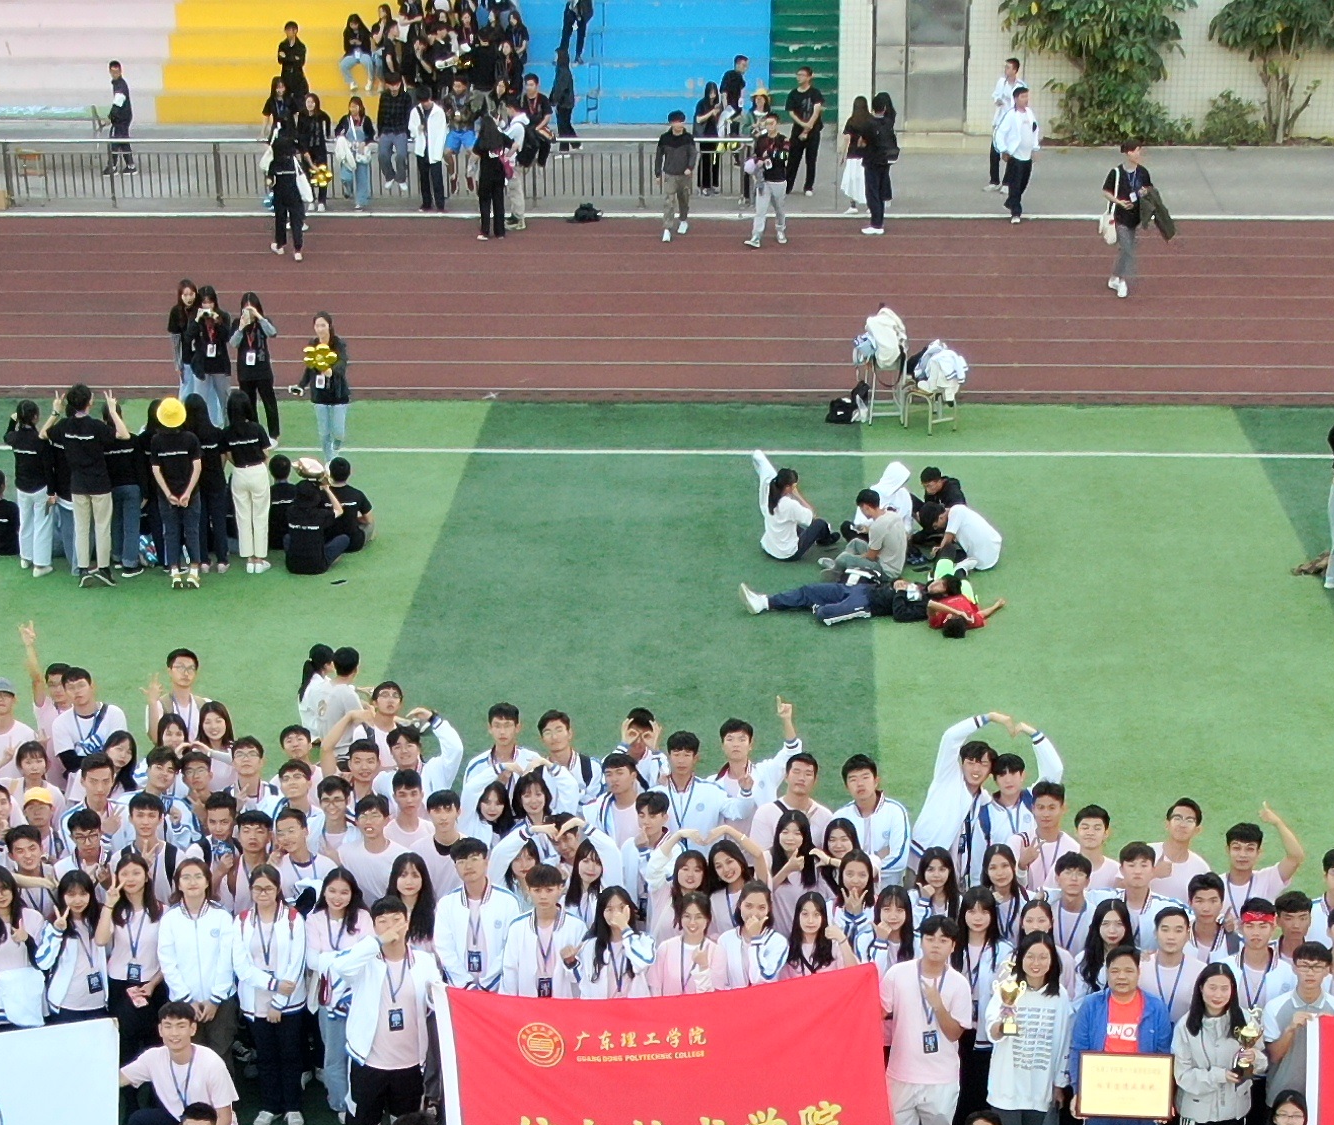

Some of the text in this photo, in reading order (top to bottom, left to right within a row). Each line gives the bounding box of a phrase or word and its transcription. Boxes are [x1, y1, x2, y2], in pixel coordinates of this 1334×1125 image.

[574, 1026, 707, 1051] 广东理工学院
